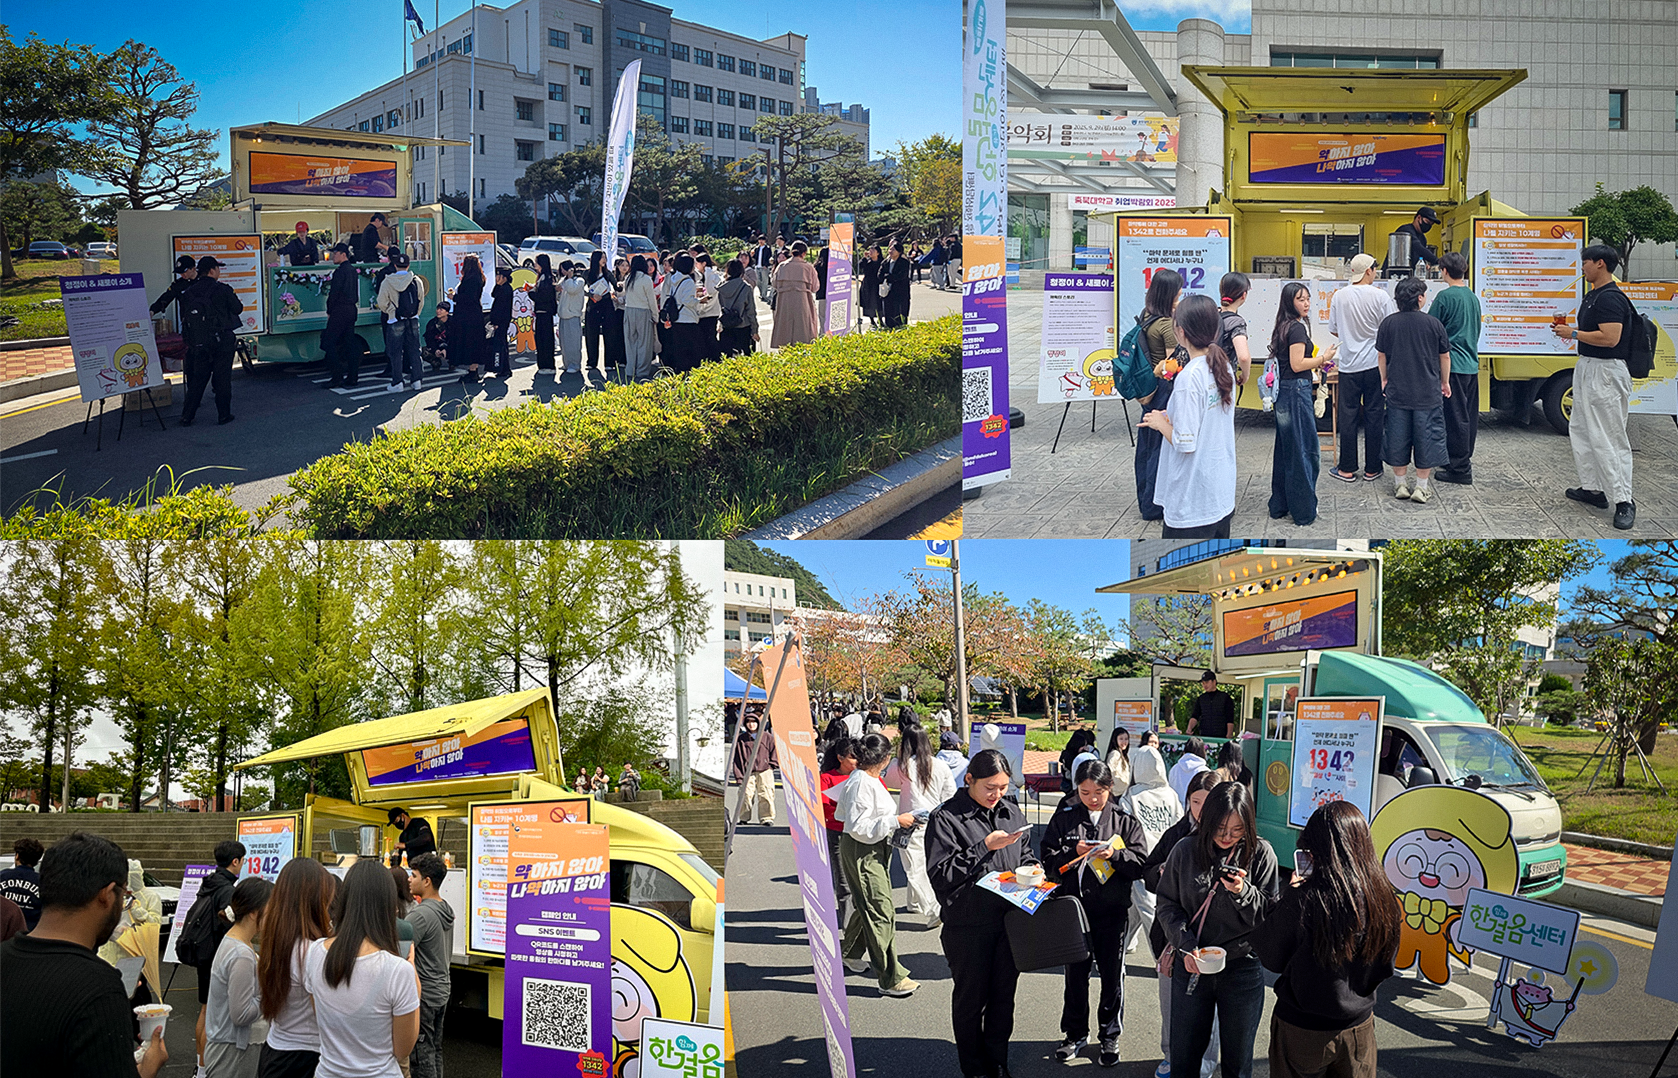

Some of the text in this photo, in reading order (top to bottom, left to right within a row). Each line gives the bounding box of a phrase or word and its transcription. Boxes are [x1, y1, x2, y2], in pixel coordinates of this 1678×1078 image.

[1319, 142, 1376, 160] 약하지 않아
[1316, 152, 1377, 173] 나약하지 않아
[1115, 198, 1153, 206] 취업박람회
[968, 263, 1000, 280] 않아
[1142, 267, 1205, 289] 142
[974, 275, 1003, 294] 않아
[1085, 279, 1109, 287] 새로이
[1263, 609, 1301, 631] 약하지 않아
[1262, 628, 1287, 645] 나약하지
[414, 737, 461, 760] 약하지 않아
[416, 747, 464, 774] 나약하지 않아
[1309, 749, 1354, 771] 1342
[247, 856, 279, 874] 1342
[515, 856, 604, 879] 약하지 않아
[0, 879, 40, 898] EONBU
[511, 871, 607, 898] 나약하지 않아
[4, 892, 31, 904] UNIV.
[562, 912, 576, 920] 안내
[1470, 904, 1566, 947] 한걸음센터
[531, 940, 558, 949] QR코드를
[572, 959, 604, 969] 남겨주세요!
[679, 1039, 694, 1049] 함께
[583, 1061, 602, 1070] 1342
[649, 1037, 724, 1078] 한걸음
